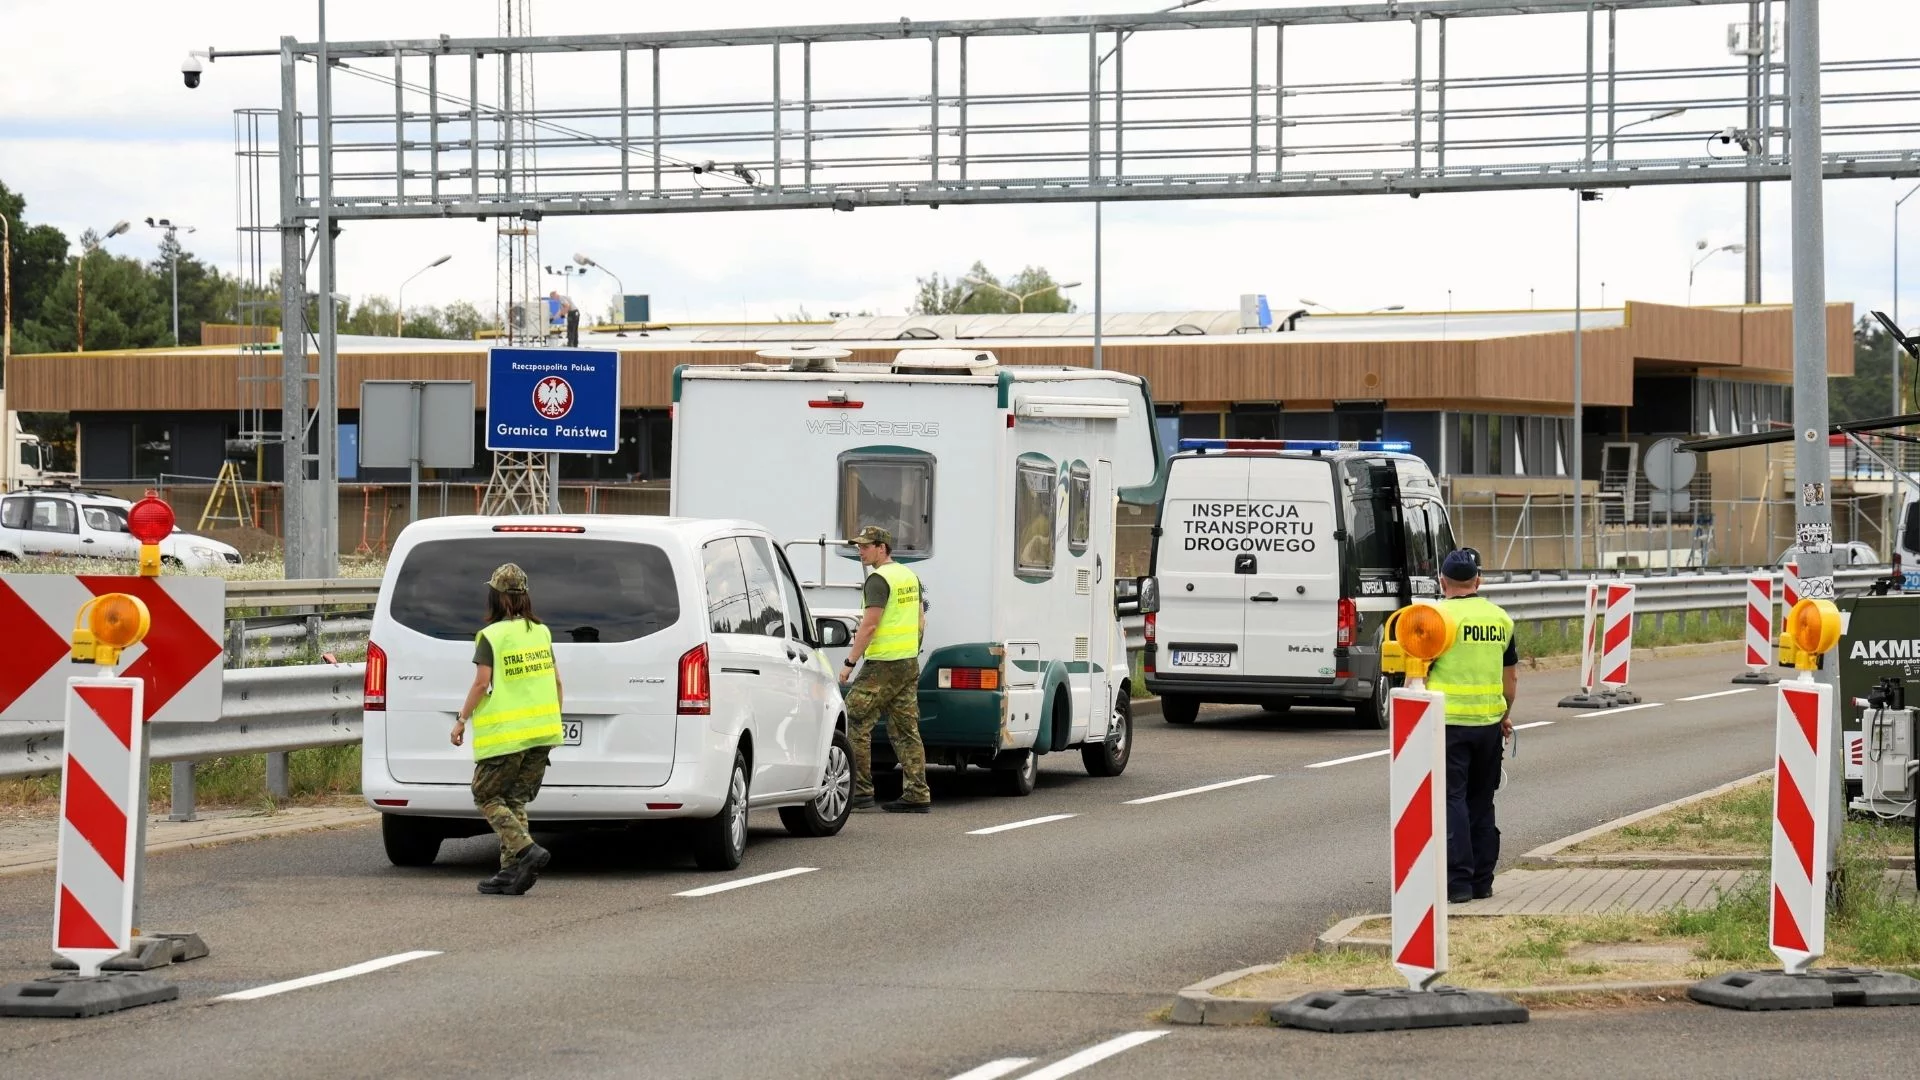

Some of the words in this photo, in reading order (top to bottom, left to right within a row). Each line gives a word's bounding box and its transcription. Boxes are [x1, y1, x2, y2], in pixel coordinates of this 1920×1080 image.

[512, 362, 568, 372] Rzeczpospolita
[571, 364, 595, 372] Polska
[497, 423, 548, 436] Granica
[556, 425, 607, 438] Państwa
[1192, 503, 1299, 518] INSPEKCJA
[1183, 520, 1313, 536] TRANSPORTU
[1184, 537, 1316, 553] DROGOWEGO
[1288, 644, 1324, 653] MAN
[1180, 652, 1194, 662] WU
[1196, 652, 1228, 664] 5353K
[1862, 659, 1895, 667] agregaty
[505, 666, 524, 677] POLISH
[524, 662, 543, 673] BORDER
